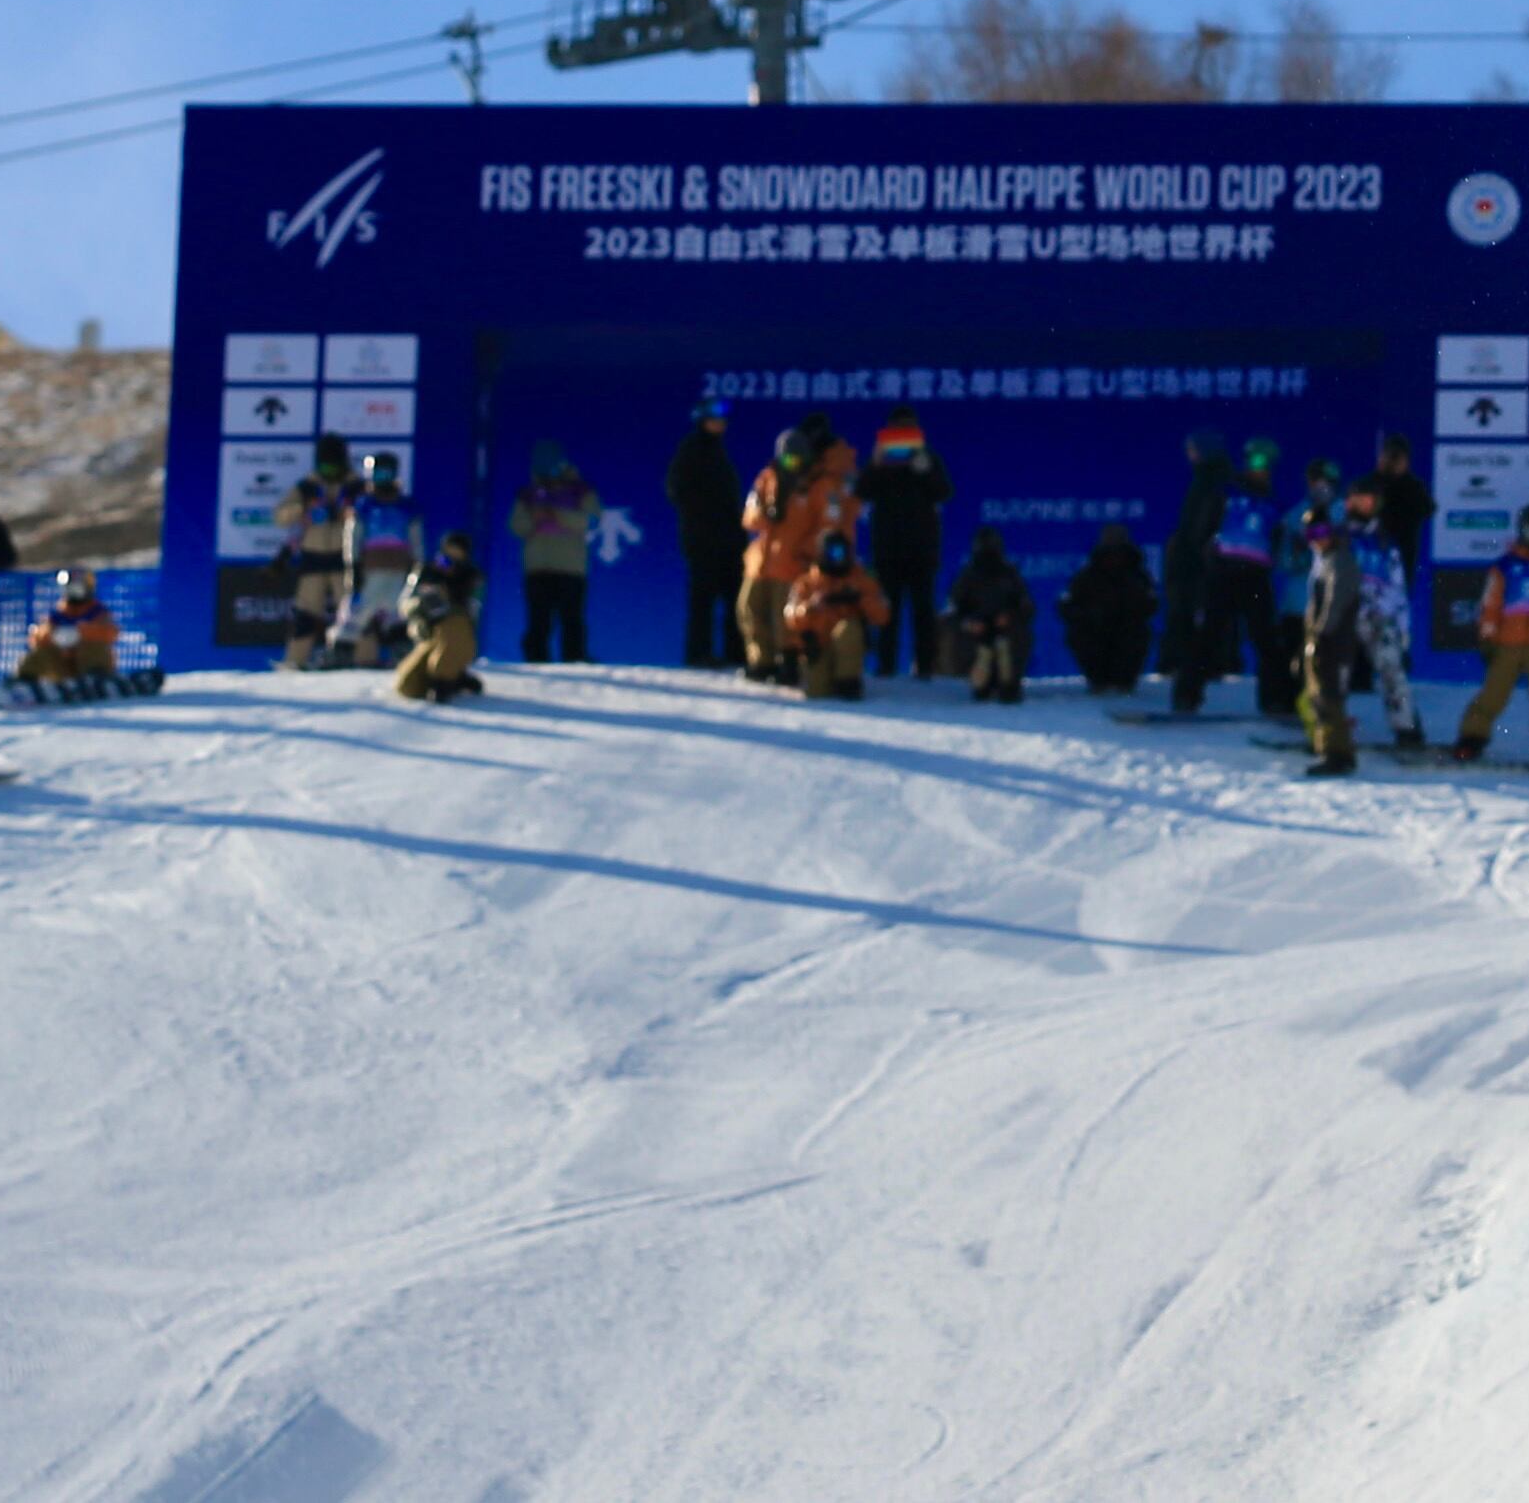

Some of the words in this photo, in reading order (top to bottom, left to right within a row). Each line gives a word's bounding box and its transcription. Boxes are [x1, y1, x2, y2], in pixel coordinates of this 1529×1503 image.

[480, 164, 532, 211] FIS
[540, 164, 673, 211] FREESKI
[681, 164, 708, 211] &
[717, 164, 926, 211] SNOWBOARD
[933, 164, 1085, 211] HALFPIPE
[1093, 164, 1211, 211] WORLD
[1218, 164, 1286, 211] CUP
[1293, 164, 1382, 211] 2023
